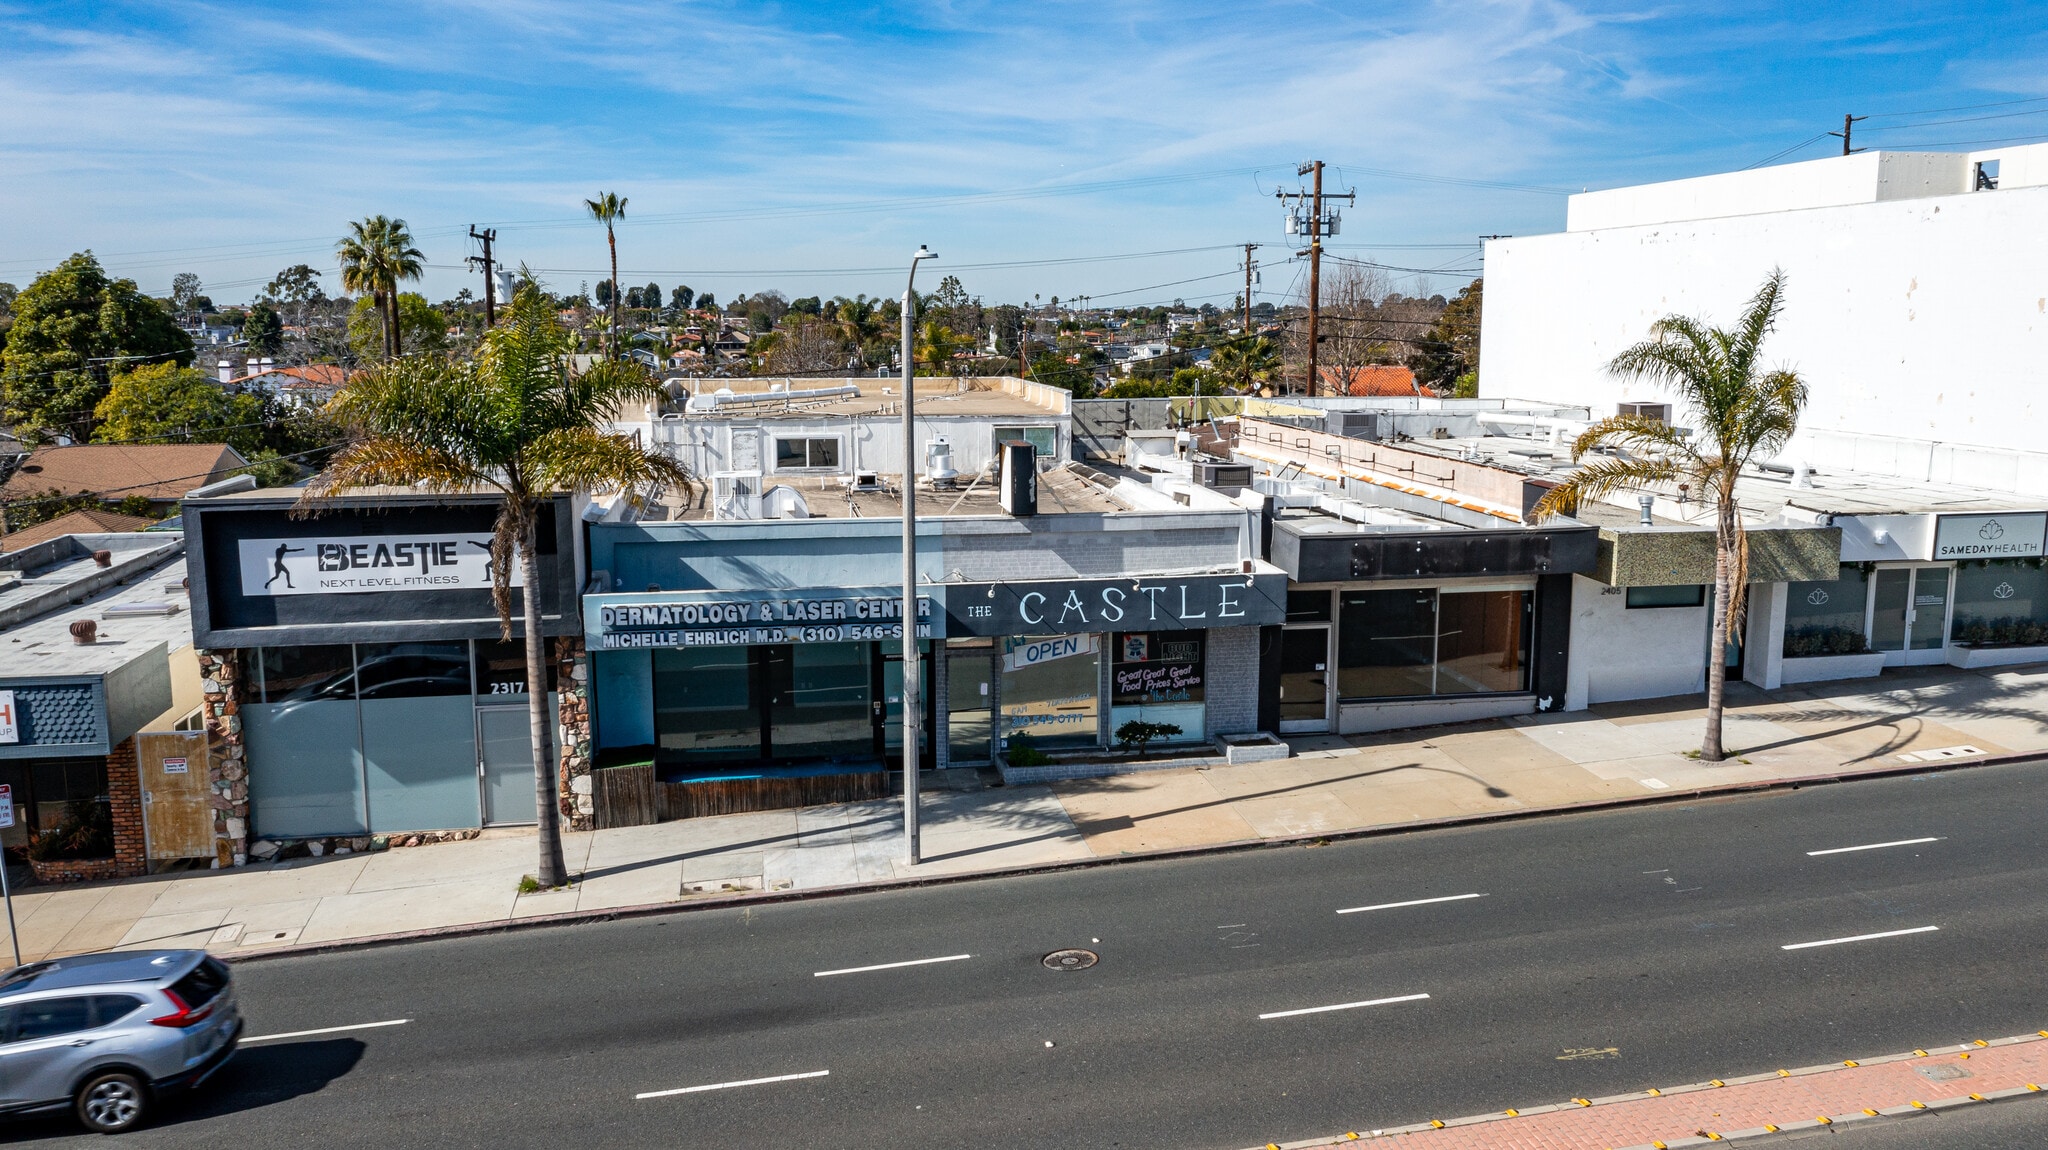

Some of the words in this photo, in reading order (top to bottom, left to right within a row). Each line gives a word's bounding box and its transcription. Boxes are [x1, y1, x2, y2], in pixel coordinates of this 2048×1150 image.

[317, 541, 459, 575] BEASTIE
[320, 579, 356, 588] NEXT
[359, 577, 401, 587] LEVEL
[404, 575, 460, 586] FITNESS
[1601, 587, 1621, 595] 2405
[601, 604, 751, 626] DERMATOLOGY
[760, 603, 774, 621] &
[782, 601, 846, 621] LASER
[855, 599, 931, 618] CENTR
[968, 606, 992, 617] THE
[1019, 583, 1247, 624] CASTLE
[602, 632, 678, 648] MICHELLE
[685, 630, 750, 645] EHRLICH
[756, 628, 788, 643] M.D.
[800, 626, 844, 643] (310)
[851, 624, 931, 640] 546-SIN
[1026, 637, 1078, 662] OPEN
[1117, 669, 1143, 683] Great
[1143, 667, 1166, 681] Great
[1169, 664, 1193, 678] Great
[490, 681, 524, 695] 2317
[1121, 679, 1142, 693] Food
[1145, 679, 1171, 691] Prices
[1173, 676, 1201, 688] Service
